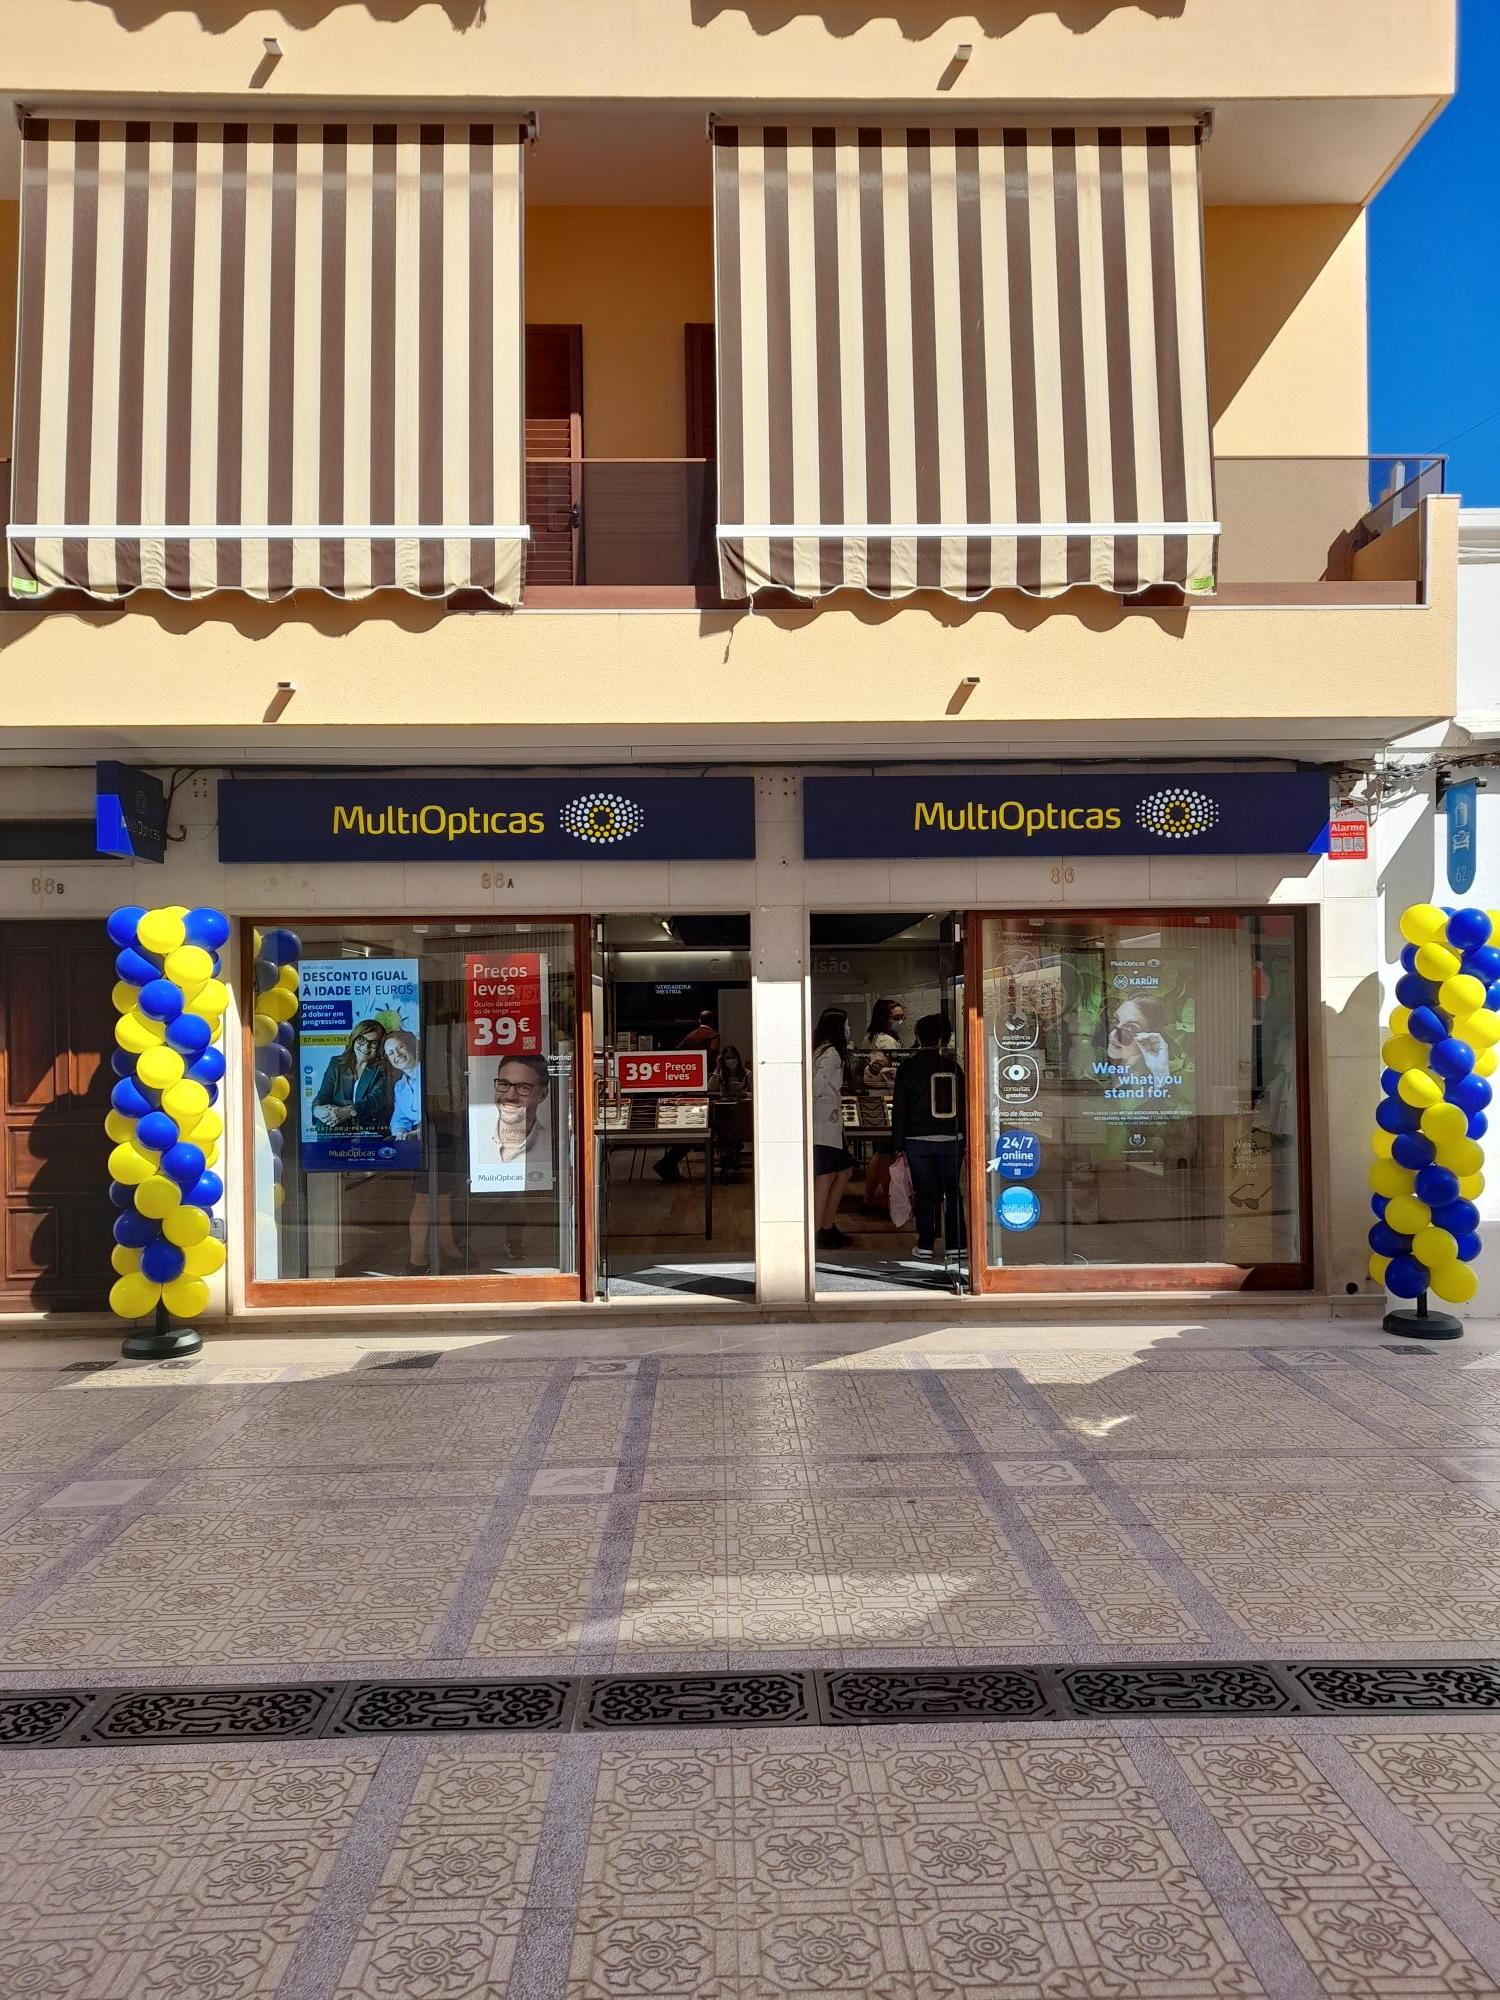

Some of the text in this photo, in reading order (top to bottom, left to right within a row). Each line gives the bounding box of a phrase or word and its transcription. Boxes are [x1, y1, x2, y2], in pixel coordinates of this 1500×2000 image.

[332, 804, 545, 841] MultiOpticas
[914, 801, 1122, 837] MultiOpticas
[1331, 824, 1365, 832] Alarme
[303, 970, 408, 982] DESCONTO IGUAL
[473, 964, 528, 983] Preços
[302, 984, 414, 996] À IDADE EM EUROS
[473, 981, 516, 996] leves
[308, 1010, 331, 1018] dobrar
[302, 1019, 346, 1027] progressivos
[474, 1017, 531, 1046] 39€
[626, 1062, 661, 1081] 39€
[665, 1062, 697, 1073] Preços
[1092, 1061, 1131, 1074] Wear
[665, 1072, 690, 1081] leves
[1118, 1072, 1182, 1088] what you
[1104, 1086, 1172, 1099] stand for.
[1002, 1136, 1034, 1150] 24/7
[1002, 1150, 1034, 1160] online
